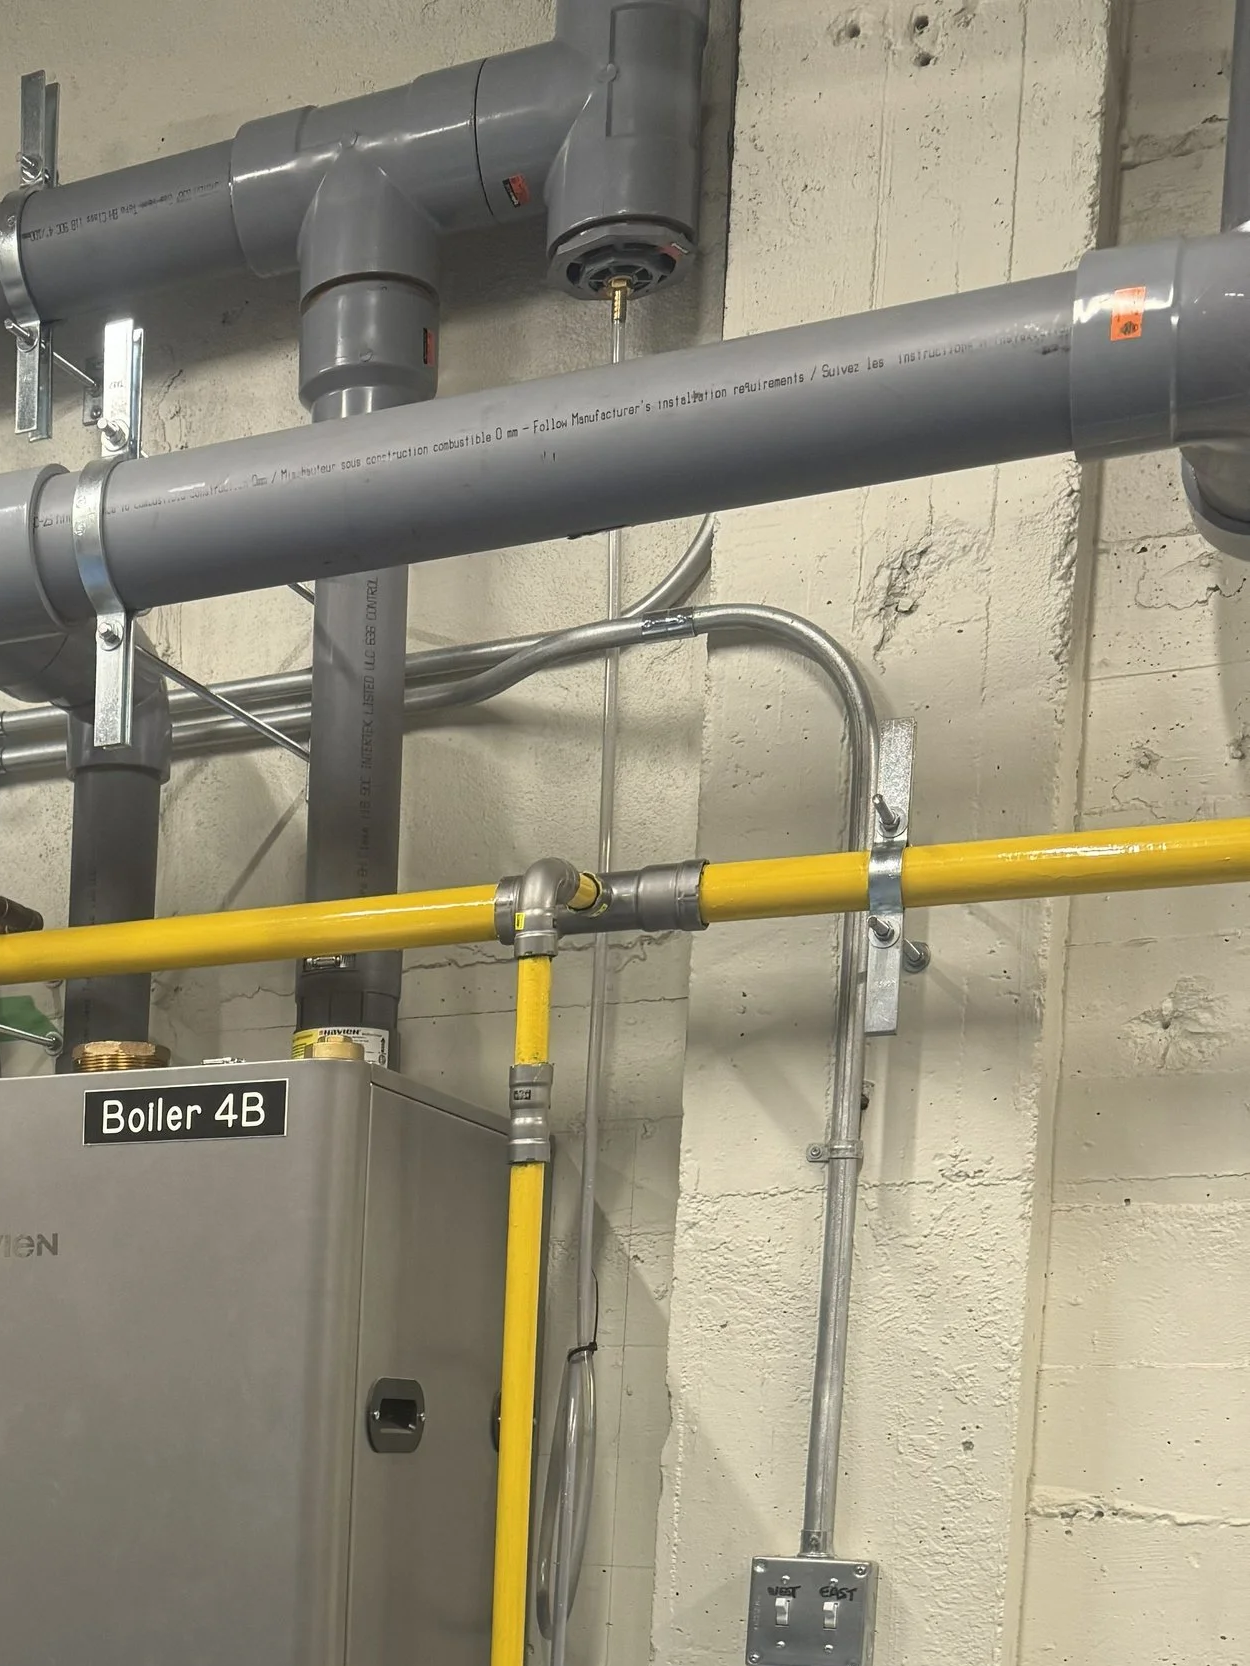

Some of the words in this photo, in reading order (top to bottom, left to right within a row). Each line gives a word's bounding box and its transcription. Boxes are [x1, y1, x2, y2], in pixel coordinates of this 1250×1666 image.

[341, 458, 362, 471] sous
[366, 445, 429, 466] construction
[433, 431, 492, 453] combustible
[533, 417, 568, 434] Follow
[571, 400, 651, 427] Manufacturer's
[733, 371, 805, 396] requirements
[821, 361, 860, 380] Suivez
[867, 356, 885, 371] les
[365, 575, 379, 621] CONTROL
[362, 675, 375, 716] LISTED
[102, 1096, 203, 1135] Boiler
[214, 1091, 266, 1128] 4B
[766, 1585, 802, 1599] WEST
[818, 1586, 858, 1602] EAST
